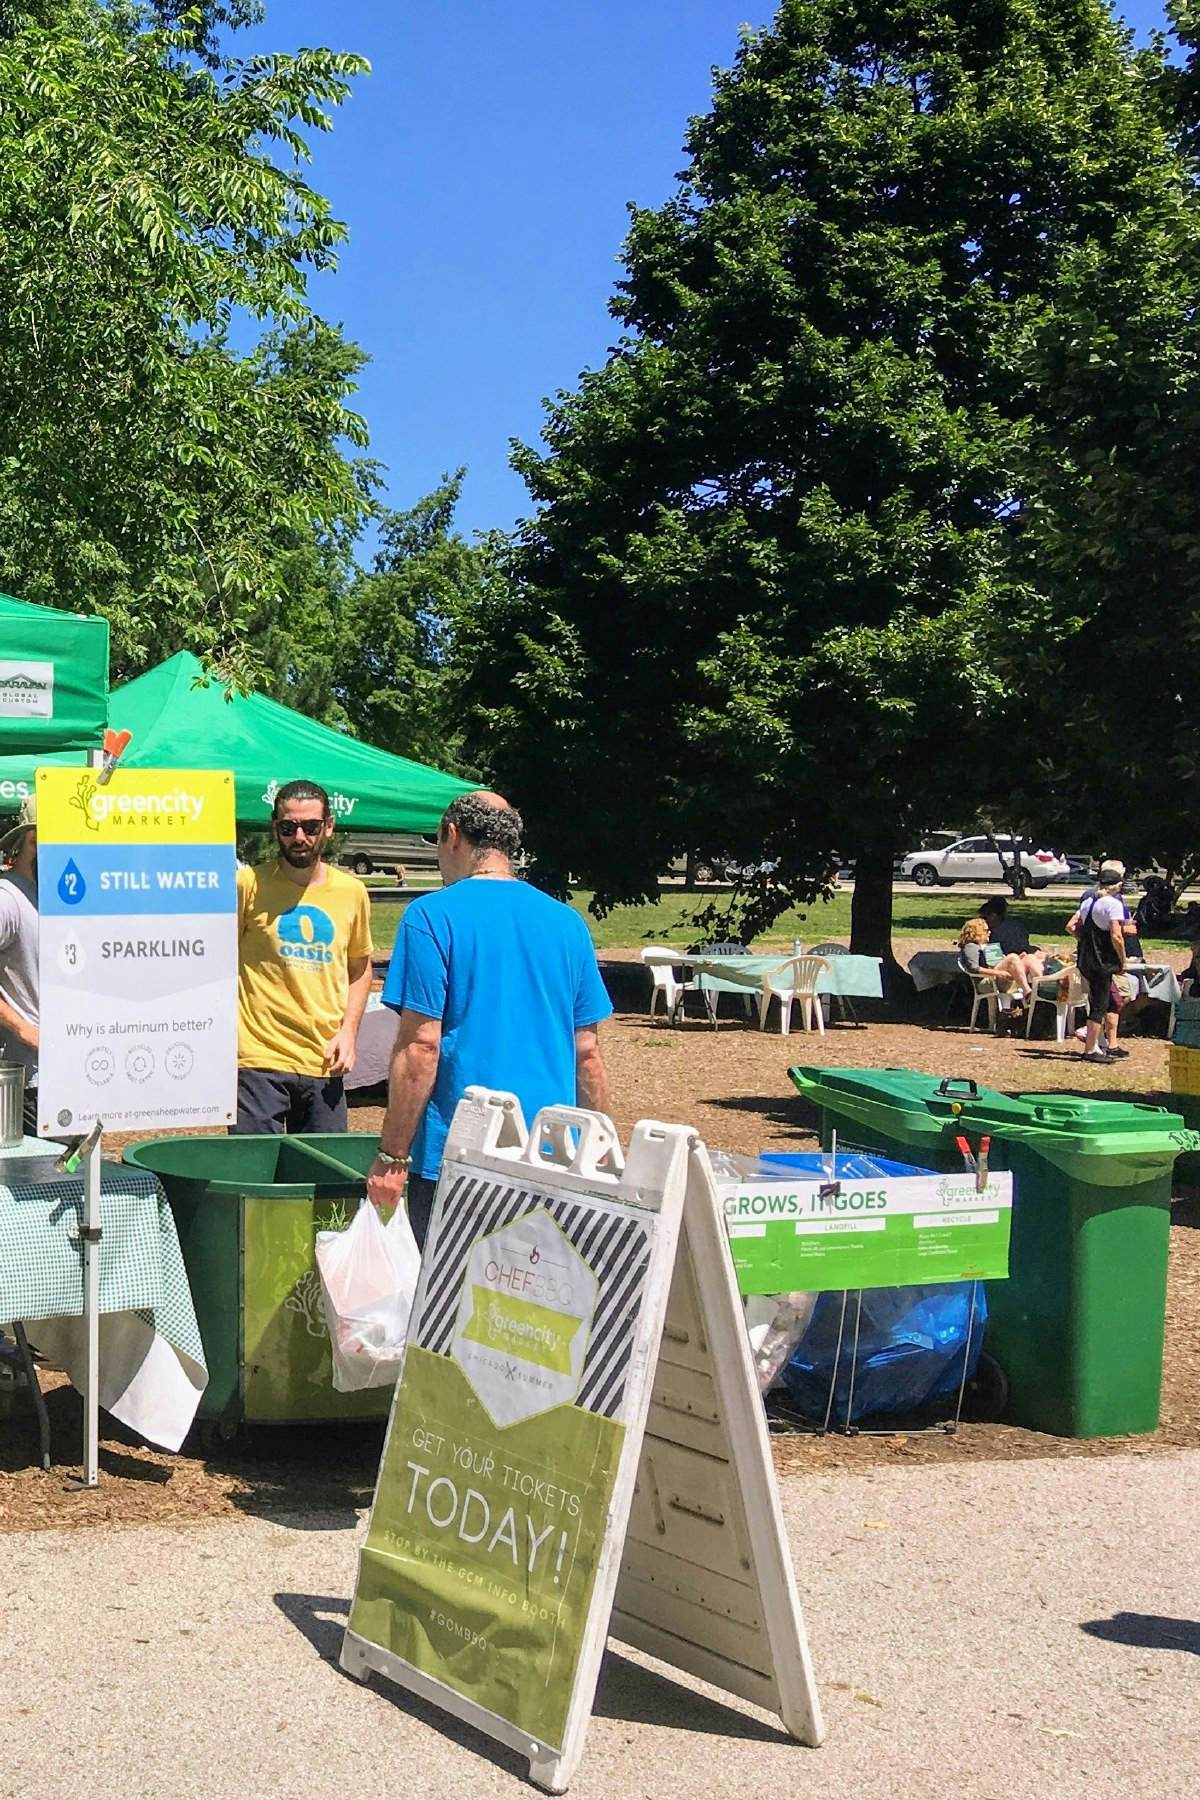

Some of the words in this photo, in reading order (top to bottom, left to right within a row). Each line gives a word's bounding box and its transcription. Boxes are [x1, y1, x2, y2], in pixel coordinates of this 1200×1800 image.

[91, 787, 205, 820] greencity
[112, 815, 187, 825] MARKET
[64, 873, 77, 895] $2
[100, 871, 150, 890] STILL
[156, 871, 220, 889] WATER
[65, 943, 77, 965] $3
[101, 939, 205, 959] SPARKLING
[279, 944, 333, 963] oasis
[66, 1023, 93, 1038] Why
[96, 1023, 105, 1035] is
[108, 1020, 169, 1034] aluminum
[172, 1018, 214, 1032] better?
[78, 1113, 99, 1121] Learn
[102, 1111, 122, 1120] more
[133, 1105, 220, 1119] greensheepwater.com
[722, 1195, 803, 1216] GROWS,
[834, 1190, 888, 1211] GOES
[946, 1184, 1000, 1201] greeity
[824, 1223, 857, 1231] LANDFILL
[942, 1215, 972, 1223] RECYCLE
[494, 1315, 561, 1352] greencity
[412, 1427, 445, 1457] GET
[453, 1443, 495, 1480] YOUR
[503, 1464, 581, 1517] TICKETS
[406, 1460, 568, 1585] TODAY!
[383, 1529, 410, 1550] STOP
[415, 1545, 428, 1559] BY
[432, 1553, 454, 1573] THE
[458, 1567, 483, 1587] GCM
[488, 1581, 517, 1605] INFO
[521, 1599, 566, 1630] BOOTH
[430, 1608, 487, 1650] #GCMBBQ
